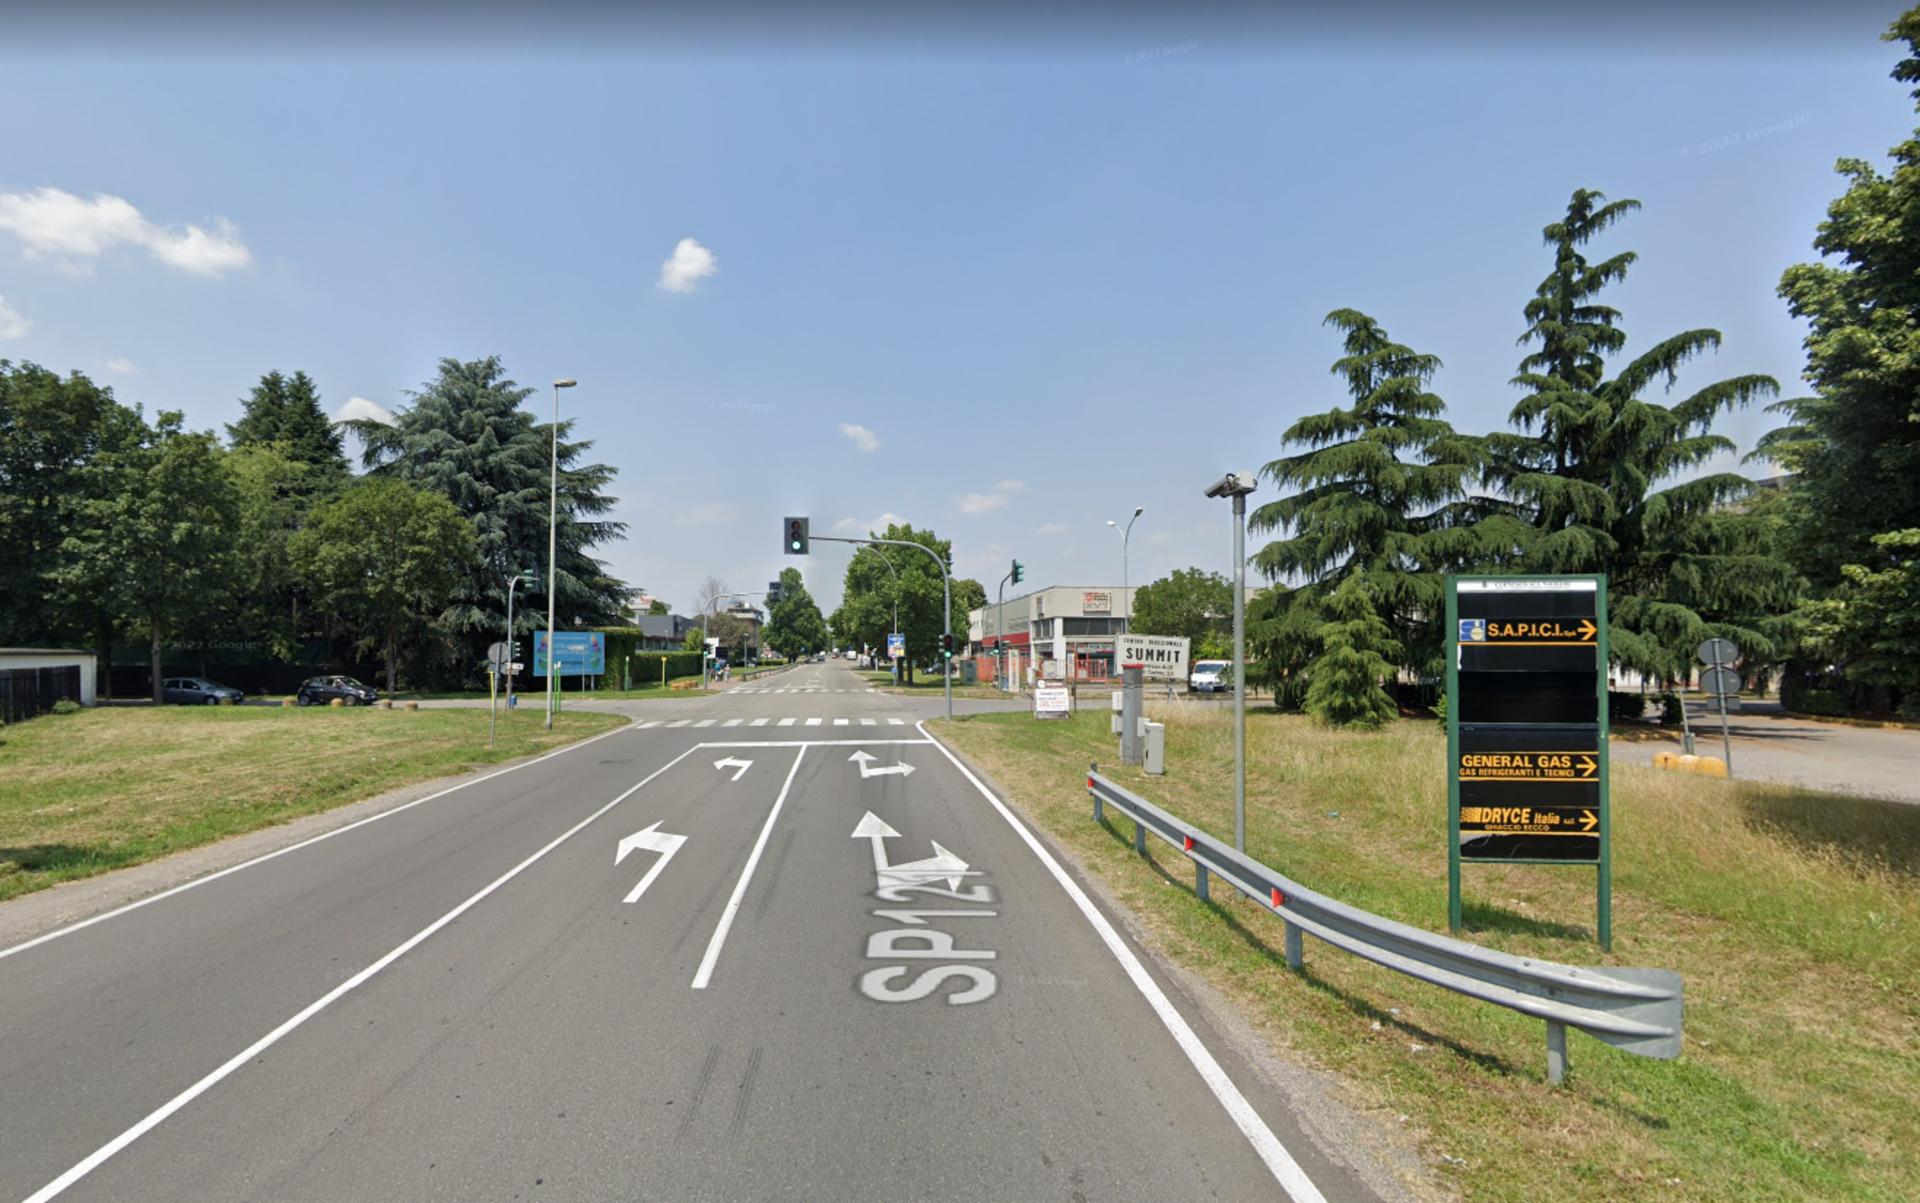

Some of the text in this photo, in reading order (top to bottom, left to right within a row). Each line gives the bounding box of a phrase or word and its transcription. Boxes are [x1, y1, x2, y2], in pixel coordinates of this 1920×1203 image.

[1487, 622, 1564, 637] S.A.P.I.C.I.
[1126, 647, 1180, 663] SUMMIT
[1462, 755, 1571, 767] GENERAL GAS
[1459, 767, 1477, 776] GAS
[1478, 767, 1534, 777] REFRIGERANTI
[1481, 807, 1531, 824] DRYCE
[1533, 812, 1560, 824] Italia
